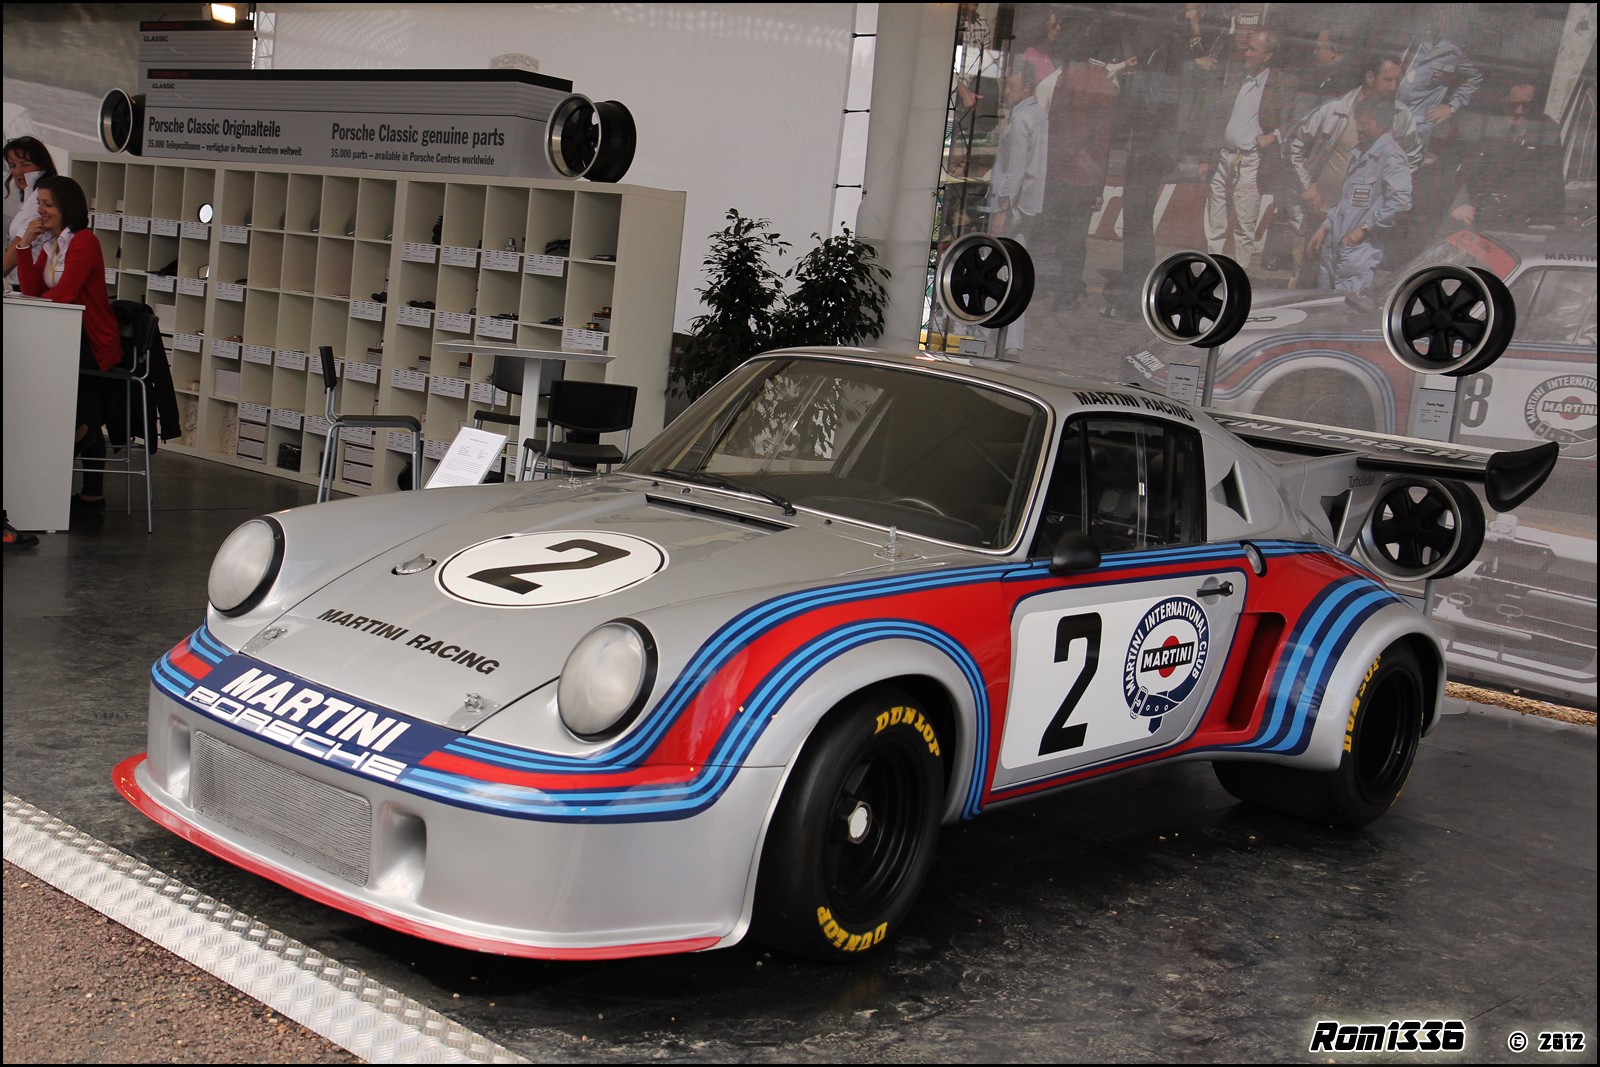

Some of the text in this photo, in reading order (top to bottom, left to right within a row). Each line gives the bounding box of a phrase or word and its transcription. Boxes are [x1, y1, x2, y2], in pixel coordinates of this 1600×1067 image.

[147, 140, 165, 149] 35.000
[166, 140, 200, 151] Teilepositionen
[231, 144, 235, 152] in
[237, 145, 257, 154] Porsche
[258, 146, 278, 155] Zentren
[280, 147, 302, 156] weltweit
[149, 116, 281, 139] Porsche Classic Originalteile
[332, 122, 505, 149] Porsche Classic genuine parts
[330, 148, 351, 158] 35.000
[352, 150, 368, 160] parts
[374, 151, 400, 161] available
[402, 151, 408, 161] in
[410, 152, 434, 163] Porsche
[436, 153, 460, 164] Centres
[462, 154, 494, 166] worldwide
[1072, 392, 1195, 422] MARTINI RACING
[1462, 372, 1493, 428] 8
[1526, 386, 1545, 424] MARTINI
[1291, 429, 1490, 463] PORSCHE
[466, 539, 631, 595] 2
[316, 608, 500, 675] MARTINI RACING
[1125, 601, 1207, 696] MARTINI INTERNATIONAL CLUB
[1143, 645, 1193, 668] MARTINI
[1037, 611, 1102, 756] 2
[186, 685, 407, 782] PORSCHE
[221, 667, 411, 753] MARTINI
[873, 706, 941, 757] DUNLOP
[816, 905, 888, 952] DUNLOP
